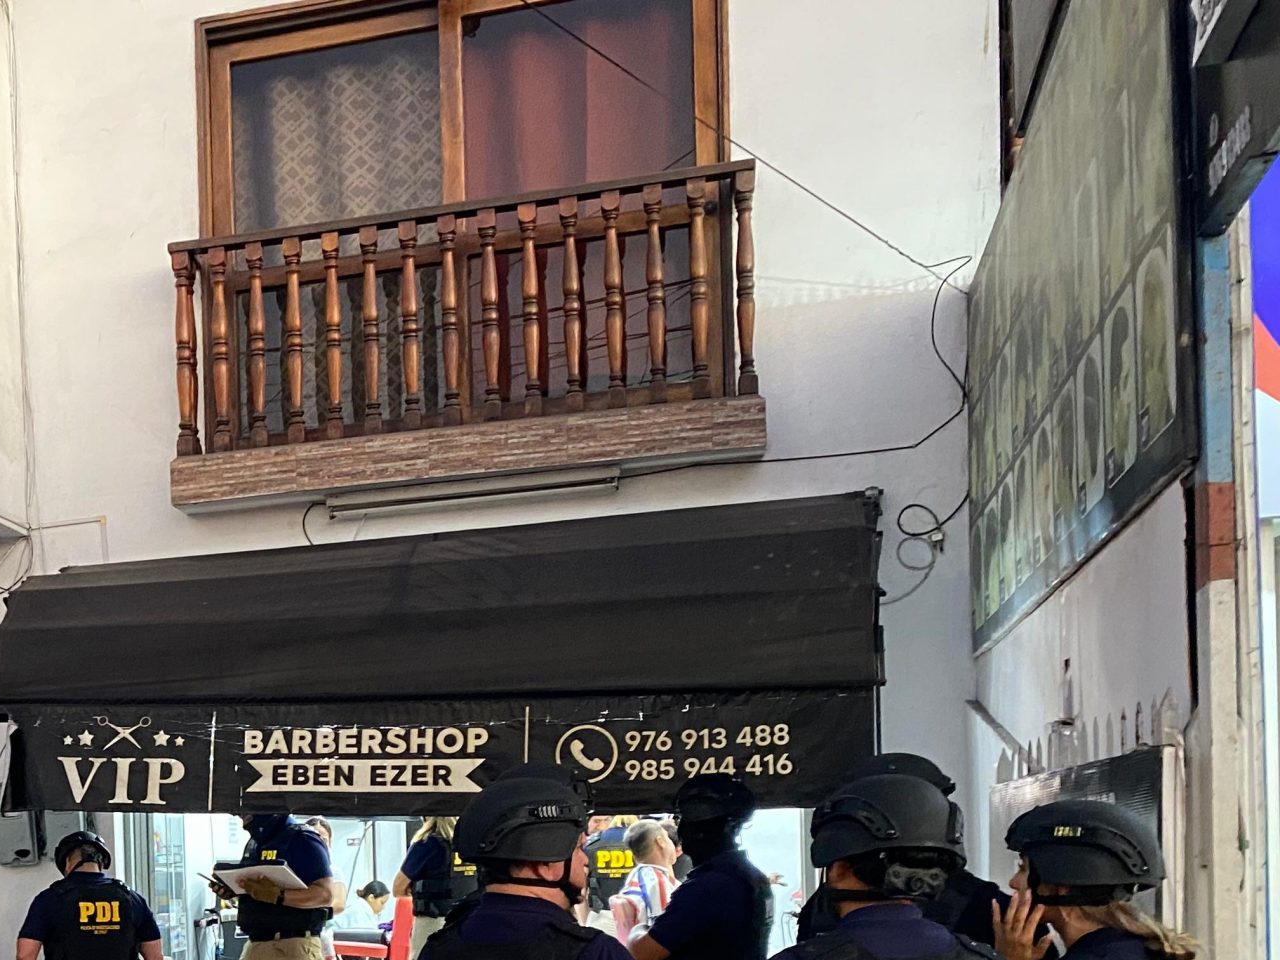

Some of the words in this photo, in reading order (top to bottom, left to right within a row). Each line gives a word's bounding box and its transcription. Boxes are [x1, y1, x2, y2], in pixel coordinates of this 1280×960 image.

[244, 727, 489, 755] BARBERSHOP
[625, 730, 672, 751] 976
[681, 727, 727, 750] 913
[735, 723, 789, 747] 488
[271, 763, 354, 787] EBEN
[370, 764, 453, 786] EZER
[624, 758, 675, 781] 985
[683, 756, 736, 779] 944
[745, 753, 793, 776] 416
[57, 757, 186, 805] VIP
[261, 850, 277, 860] PDI
[597, 850, 634, 867] PDI
[79, 901, 120, 922] PDI
